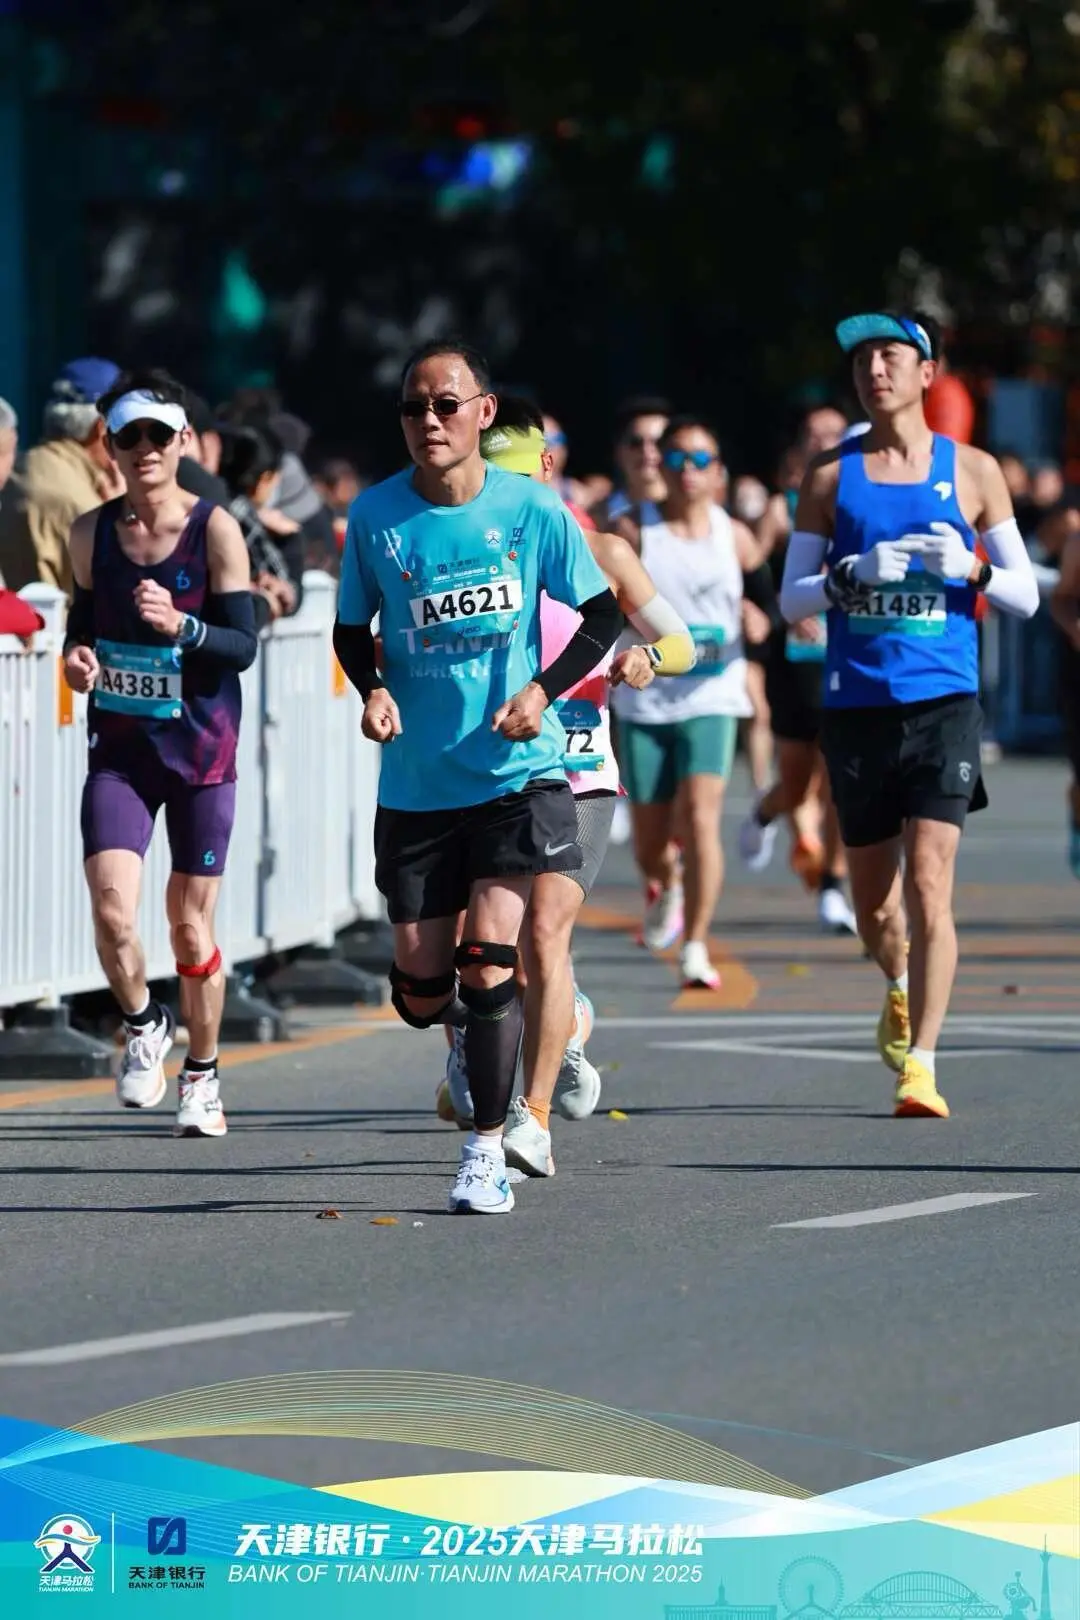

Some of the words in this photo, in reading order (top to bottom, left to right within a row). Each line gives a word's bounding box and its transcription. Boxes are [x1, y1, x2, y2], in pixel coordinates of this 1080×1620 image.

[422, 584, 514, 626] A4621
[102, 669, 172, 699] A4381
[564, 729, 595, 753] 72
